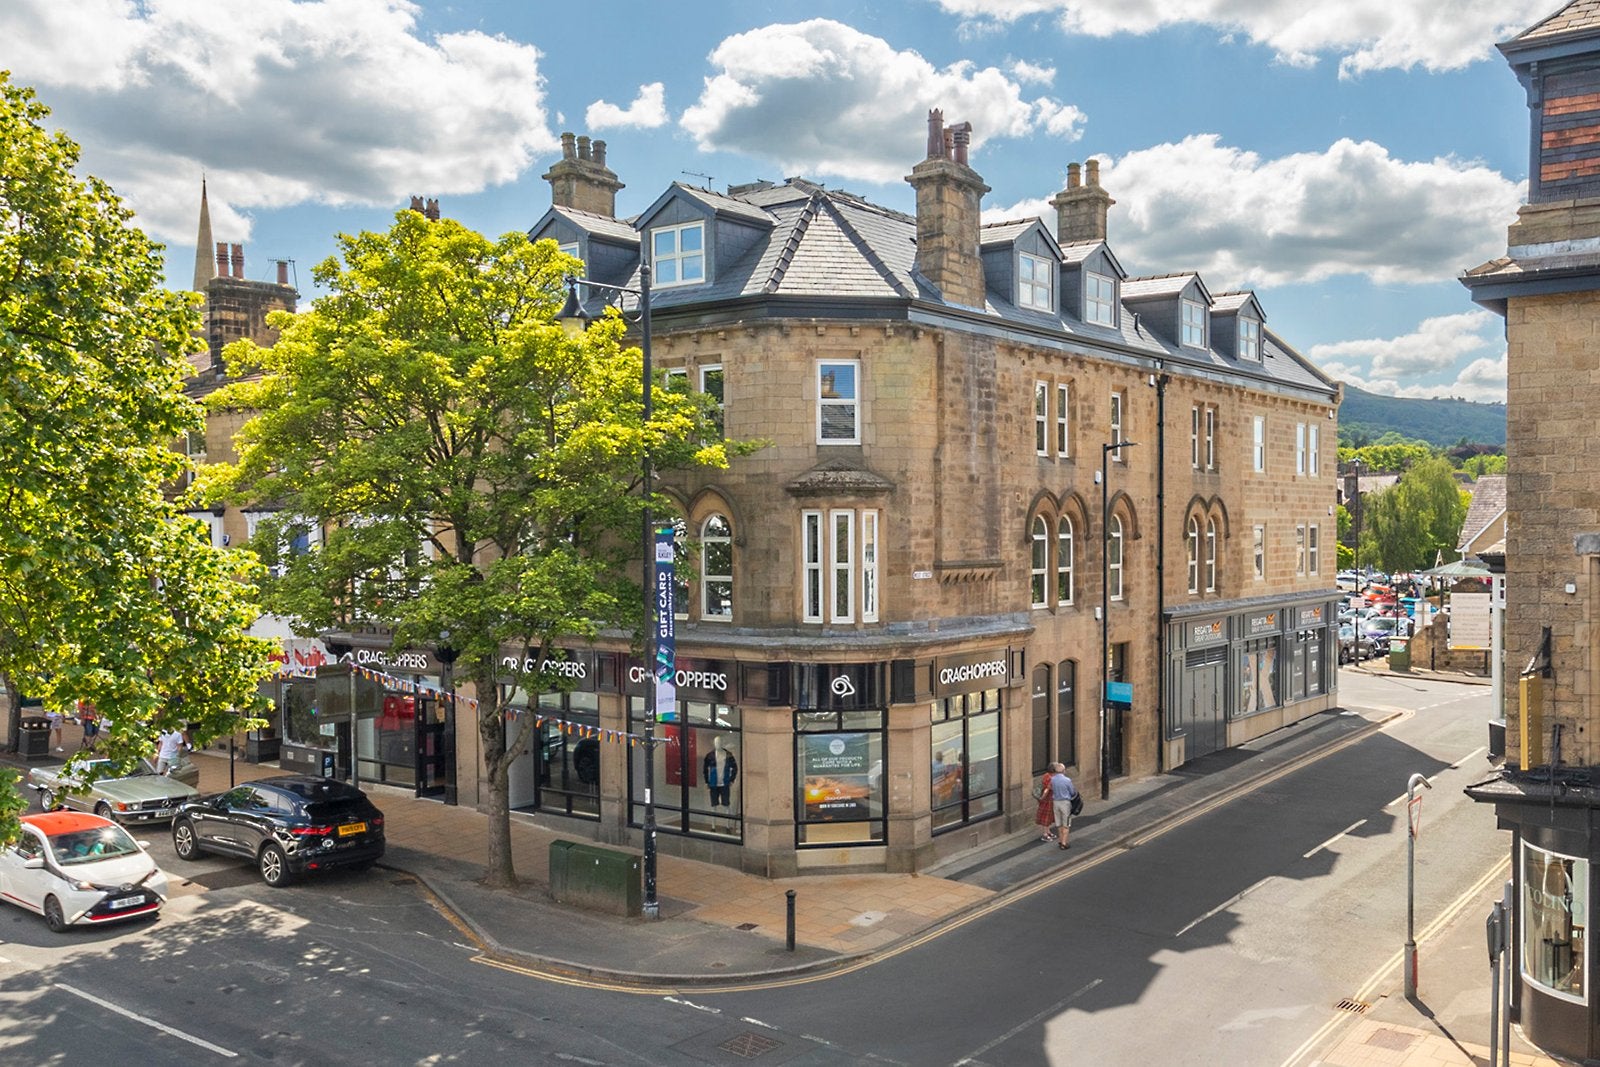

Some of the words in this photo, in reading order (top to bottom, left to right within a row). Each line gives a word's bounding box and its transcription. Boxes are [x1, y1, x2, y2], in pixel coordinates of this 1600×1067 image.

[659, 572, 667, 608] CARD
[660, 610, 668, 638] GIFT
[940, 659, 1006, 685] CRAGHOPPERS
